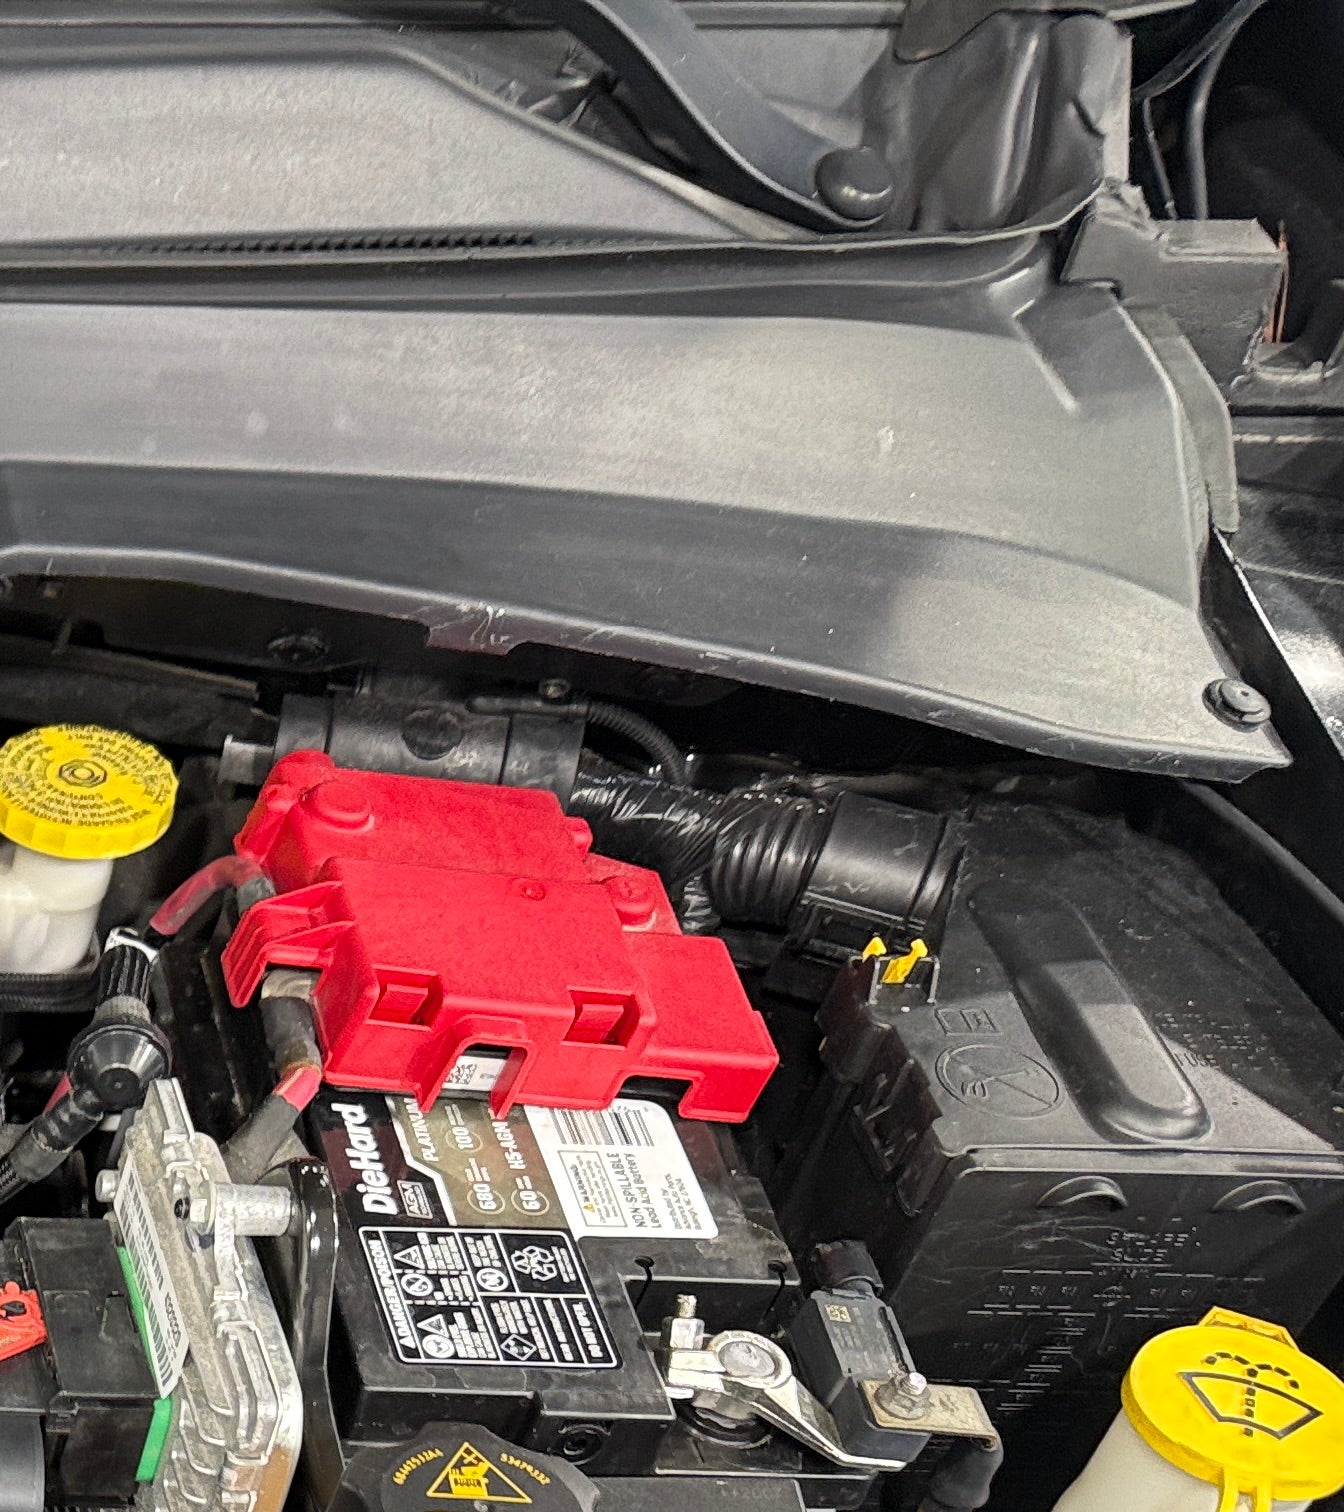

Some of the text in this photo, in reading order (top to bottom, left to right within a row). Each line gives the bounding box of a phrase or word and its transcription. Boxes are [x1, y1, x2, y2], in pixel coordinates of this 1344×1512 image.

[404, 1098, 439, 1161] PLATINUM
[450, 1127, 476, 1149] 100
[331, 1102, 399, 1215] DieHard
[471, 1184, 498, 1210] 680
[519, 1190, 541, 1210] 60
